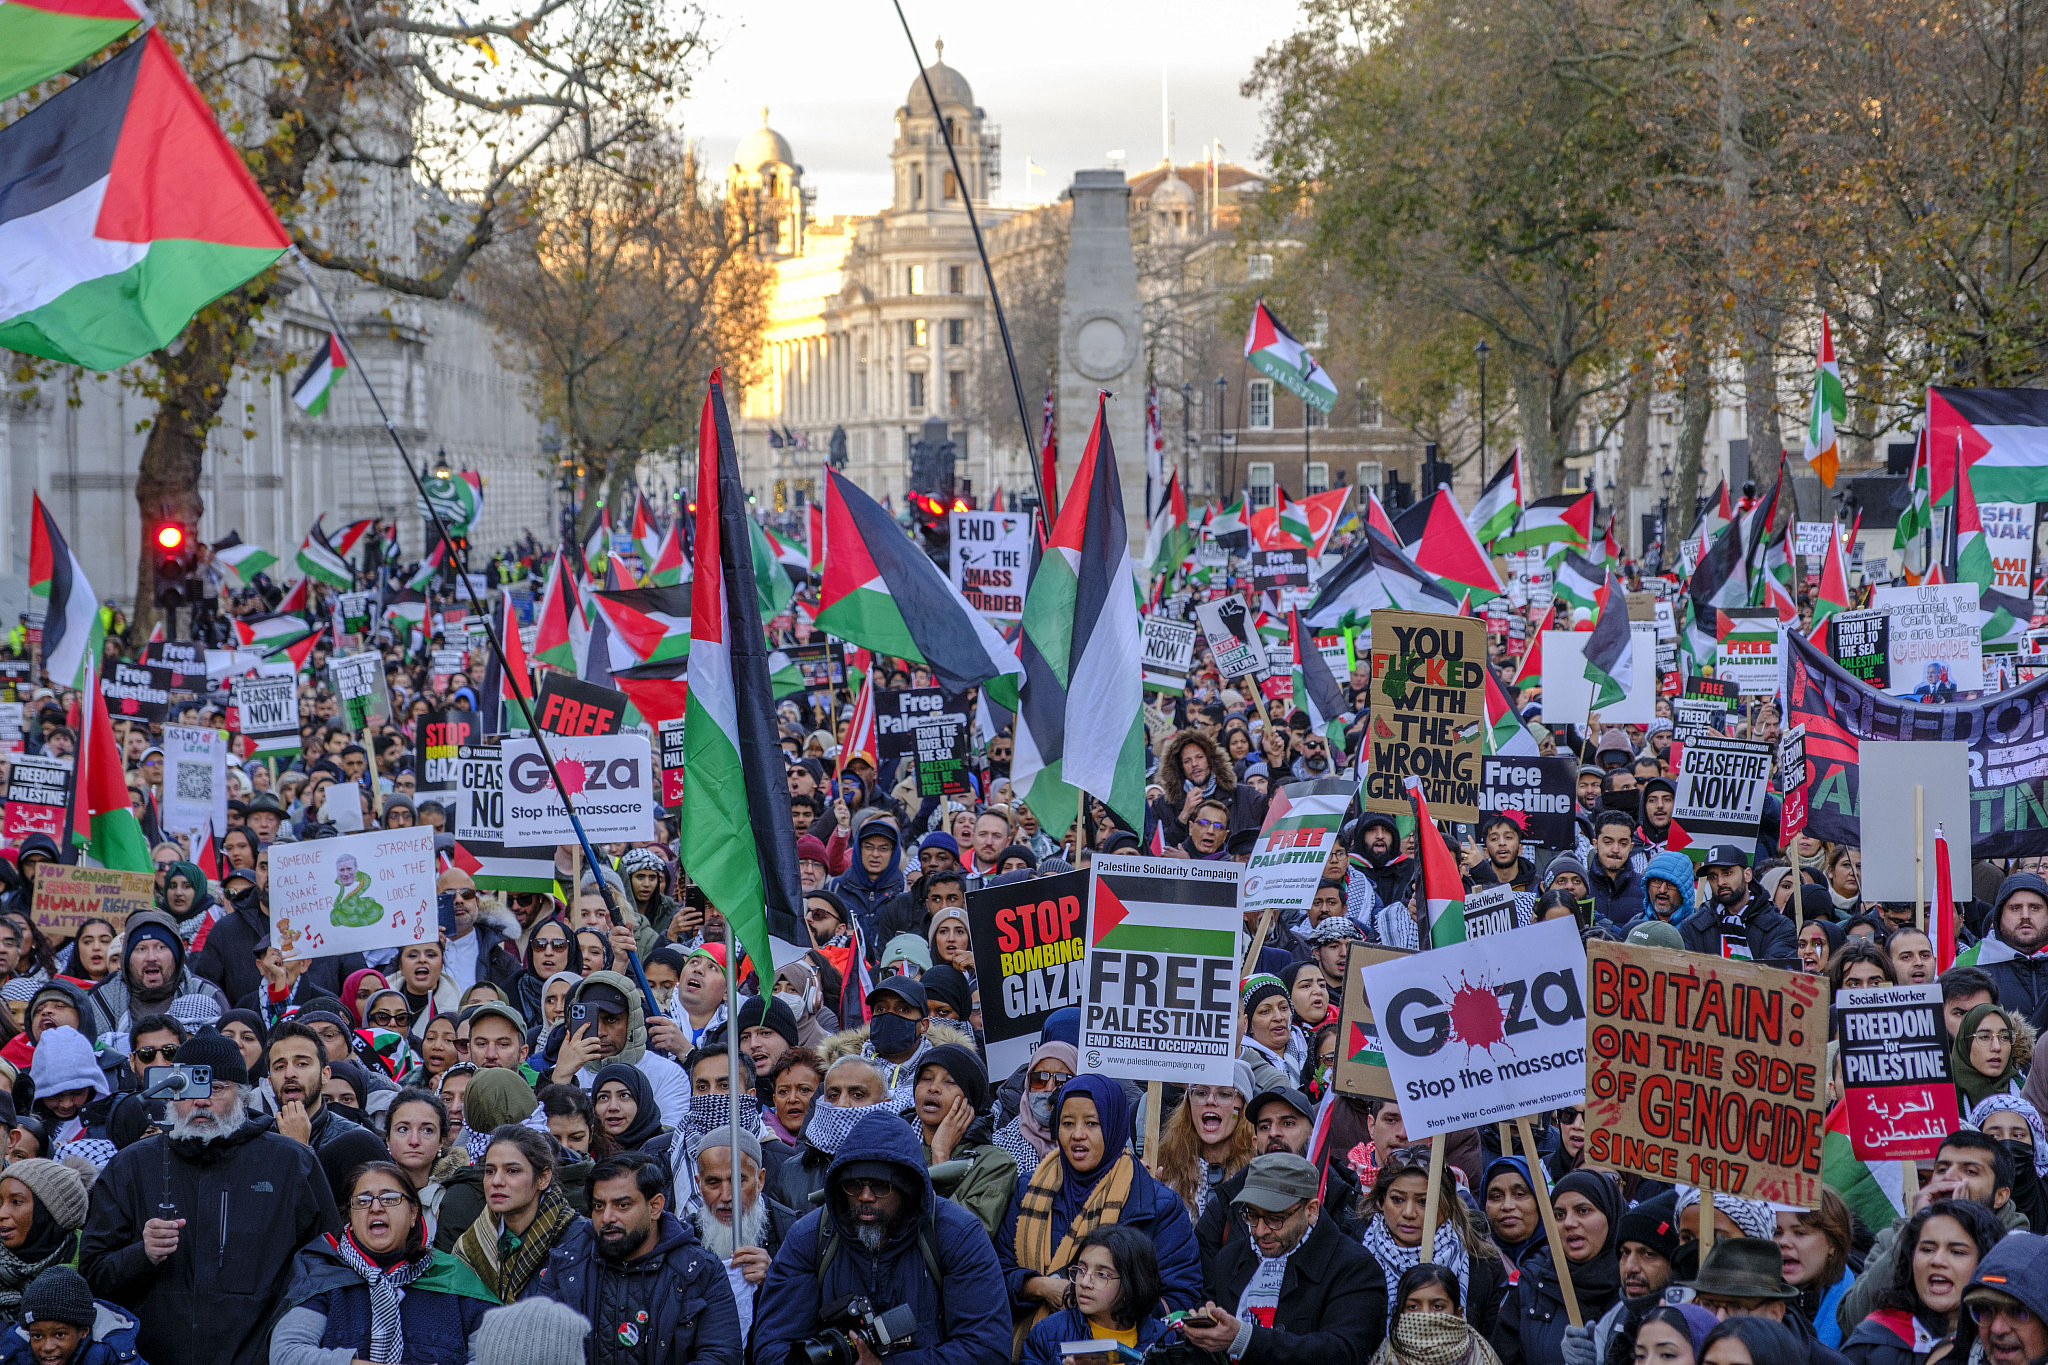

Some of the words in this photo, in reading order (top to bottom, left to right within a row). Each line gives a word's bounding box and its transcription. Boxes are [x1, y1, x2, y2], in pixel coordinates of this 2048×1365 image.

[1264, 363, 1331, 414] PALESTINE
[958, 518, 995, 541] END
[993, 550, 1020, 568] THE
[1265, 552, 1293, 565] Free
[967, 568, 1011, 587] MASS
[1254, 563, 1308, 578] Palestine
[1917, 587, 1939, 603] UK
[1953, 597, 1977, 613] You
[1838, 621, 1865, 635] FROM
[1866, 618, 1883, 631] THE
[1934, 611, 1959, 625] hide
[1144, 623, 1192, 646] CEASEFIRE
[1391, 626, 1464, 662] YOU
[1839, 633, 1866, 647] RIVER
[1867, 631, 1879, 643] TO
[1910, 629, 1934, 639] are
[1937, 625, 1982, 647] backing
[162, 642, 195, 660] Free
[1145, 638, 1187, 664] NOW!
[1726, 640, 1772, 655] FREE
[1840, 645, 1857, 658] THE
[1858, 643, 1876, 656] SEA
[1892, 639, 1970, 664] GENOCIDE
[337, 664, 360, 679] FROM
[360, 661, 376, 673] THE
[1719, 657, 1778, 666] PALESTINE
[1840, 653, 1885, 669] PALESTINE
[114, 662, 152, 685] Free
[339, 677, 361, 690] RIVER
[362, 673, 374, 684] TO
[1863, 667, 1875, 678] BE
[101, 677, 168, 705] Palestine
[241, 685, 292, 704] CEASEFIRE
[341, 689, 357, 701] THE
[357, 684, 372, 697] SEA
[1700, 681, 1724, 695] FREE
[899, 693, 944, 713] Free
[1391, 686, 1467, 714] WITH
[249, 701, 290, 724] NOW!
[541, 692, 614, 736] FREE
[425, 722, 471, 747] STOP
[915, 726, 940, 740] FROM
[941, 724, 958, 737] THE
[1393, 713, 1455, 746] THE
[916, 737, 942, 751] RIVER
[943, 736, 955, 749] TO
[1697, 738, 1721, 748] PALESTINE
[918, 750, 935, 763] THE
[935, 748, 953, 761] SEA
[919, 758, 963, 774] PALESTINE
[1374, 741, 1473, 782] WRONG
[1685, 750, 1769, 780] CEASEFIRE
[13, 766, 66, 786] FREEDOM
[425, 757, 459, 783] GAZ
[508, 752, 640, 794] Gza
[920, 772, 942, 784] WILL
[942, 770, 953, 782] BE
[1485, 760, 1542, 787] Free
[8, 785, 65, 807] PALESTINE
[921, 784, 943, 796] FREE
[1366, 771, 1479, 807] GENRATION
[1688, 775, 1757, 812] NOW!
[1478, 786, 1571, 814] alestine
[511, 805, 543, 820] Stop
[547, 804, 570, 816] the
[574, 802, 642, 816] massacre
[1675, 808, 1688, 816] FREE
[1689, 809, 1716, 819] PALESTINE
[1719, 811, 1729, 819] END
[1730, 812, 1759, 822] APARTHEID
[458, 829, 473, 838] FREE
[474, 829, 504, 839] PALESTINE
[1265, 827, 1328, 853] FREE
[276, 850, 322, 871] SOMEONE
[1249, 850, 1327, 869] PALESTINE
[39, 865, 65, 878] YOU
[71, 869, 122, 884] CANNOT
[276, 875, 299, 888] CALL
[307, 871, 316, 882] A
[379, 869, 395, 881] ON
[402, 860, 426, 875] THE
[1097, 861, 1141, 874] Palestine
[1143, 864, 1189, 878] Solidarity
[1191, 867, 1239, 881] Campaign
[45, 881, 91, 896] CHOOSE
[285, 883, 318, 902] SNAKE
[386, 883, 417, 901] LOOSE
[36, 893, 100, 913] HUMAN
[279, 896, 335, 919] CHARMER
[995, 895, 1081, 953] STOP
[1000, 937, 1084, 978] BOMBING
[1002, 960, 1085, 1020] GAZA
[1088, 950, 1234, 1013] FREE
[1384, 967, 1587, 1058] Gza
[1593, 957, 1805, 1047] BRITAIN:
[1086, 1005, 1230, 1039] PALESTINE
[1845, 1008, 1936, 1041] FREEDOM
[1087, 1033, 1110, 1047] END
[1112, 1035, 1156, 1051] ISRAELI
[1158, 1039, 1228, 1056] OCCUPATION
[1883, 1039, 1900, 1053] for
[1107, 1055, 1205, 1071] www.palestinecampaign.org
[1592, 1024, 1650, 1067] ON
[1657, 1034, 1724, 1080] THE
[1732, 1049, 1817, 1102] SIDE
[1845, 1050, 1947, 1083] PALESTINE
[1406, 1076, 1456, 1102] Stop
[1459, 1063, 1493, 1089] the
[1866, 1090, 1935, 1120] الحرية
[1427, 1118, 1446, 1129] Stop
[1447, 1114, 1461, 1124] the
[1462, 1111, 1478, 1121] War
[1480, 1103, 1516, 1117] Coalition
[1592, 1068, 1637, 1103] OF
[1638, 1074, 1825, 1174] GENOCIDE
[1864, 1117, 1948, 1149] لفلسطين
[1589, 1127, 1679, 1179] SINCE
[1686, 1152, 1750, 1195] 1917
